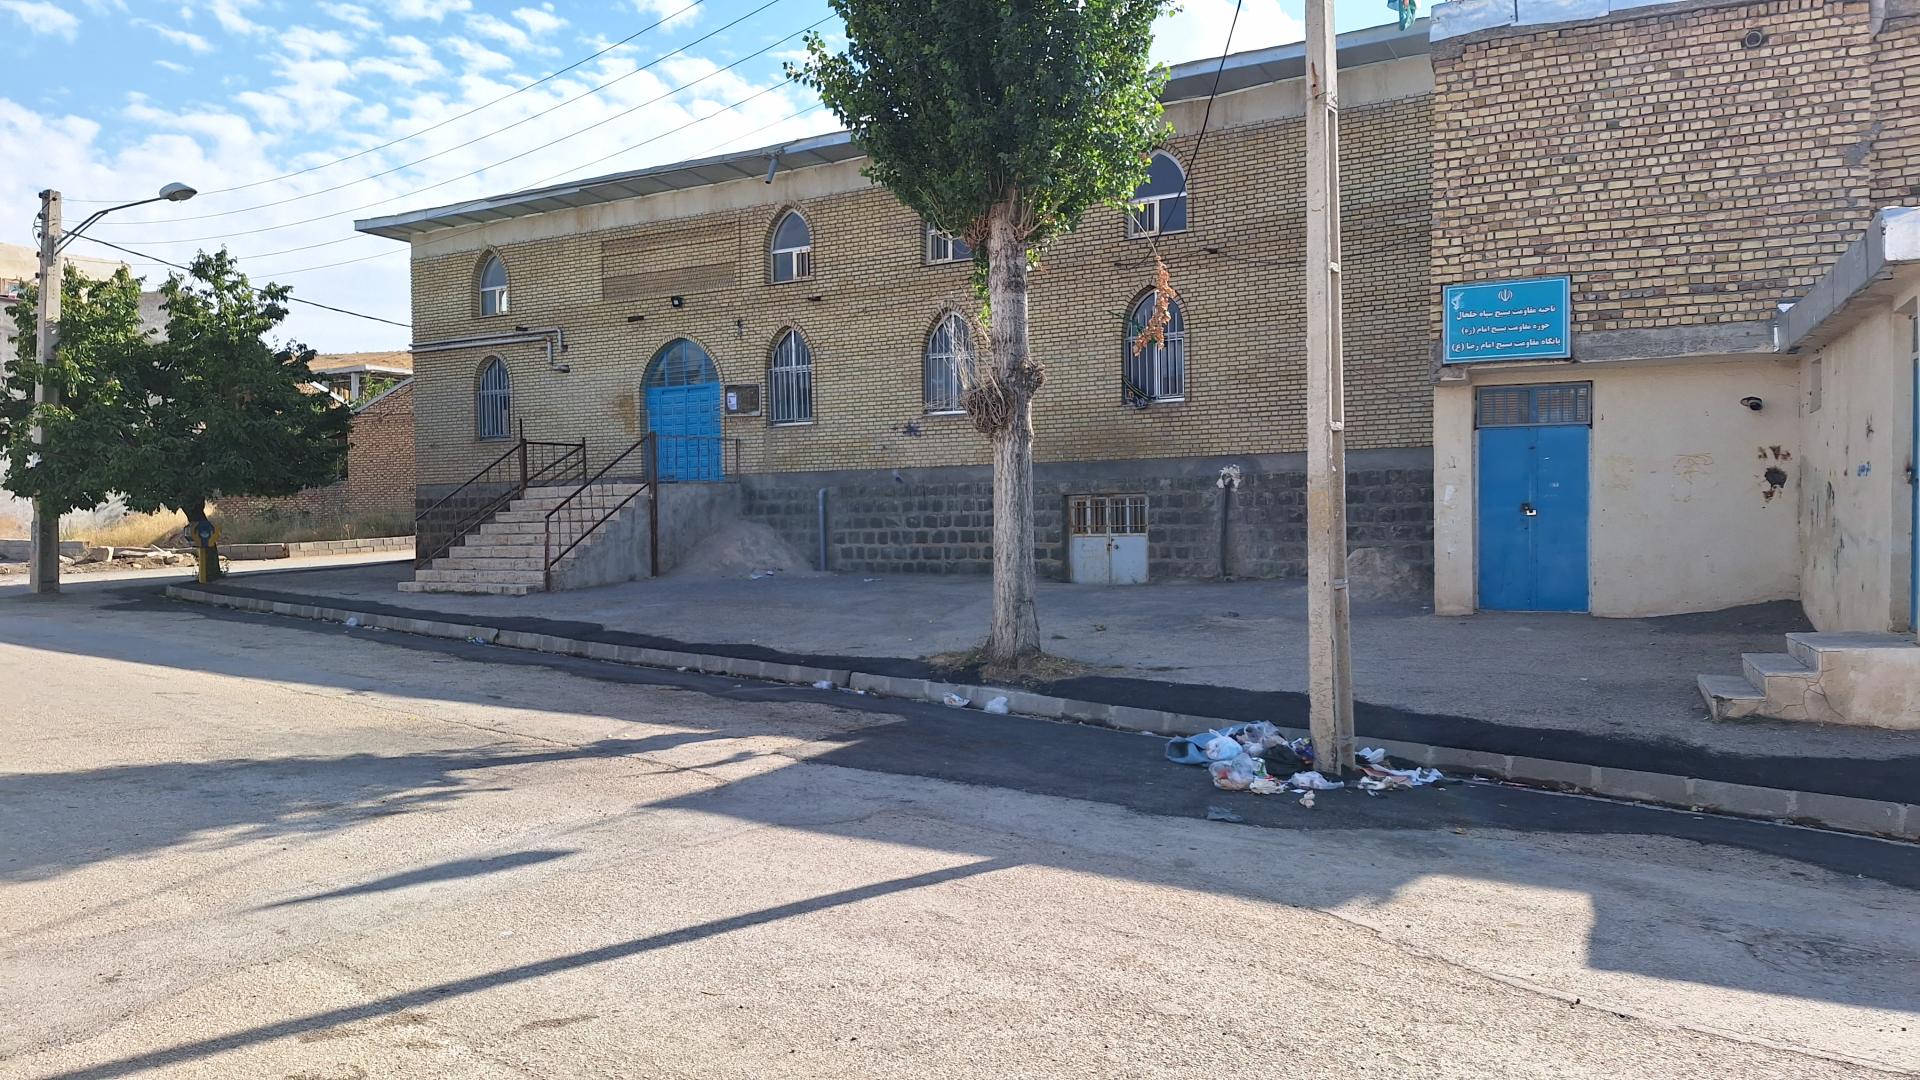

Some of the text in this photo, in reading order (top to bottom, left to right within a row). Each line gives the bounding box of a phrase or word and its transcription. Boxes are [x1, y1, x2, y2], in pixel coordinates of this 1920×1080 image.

[1512, 307, 1536, 315] مقاومت
[1538, 304, 1556, 312] ناحیه
[1494, 310, 1510, 318] بسیج
[1480, 342, 1495, 350] امام
[1496, 342, 1513, 350] بسیج
[1514, 340, 1539, 348] مقاومت
